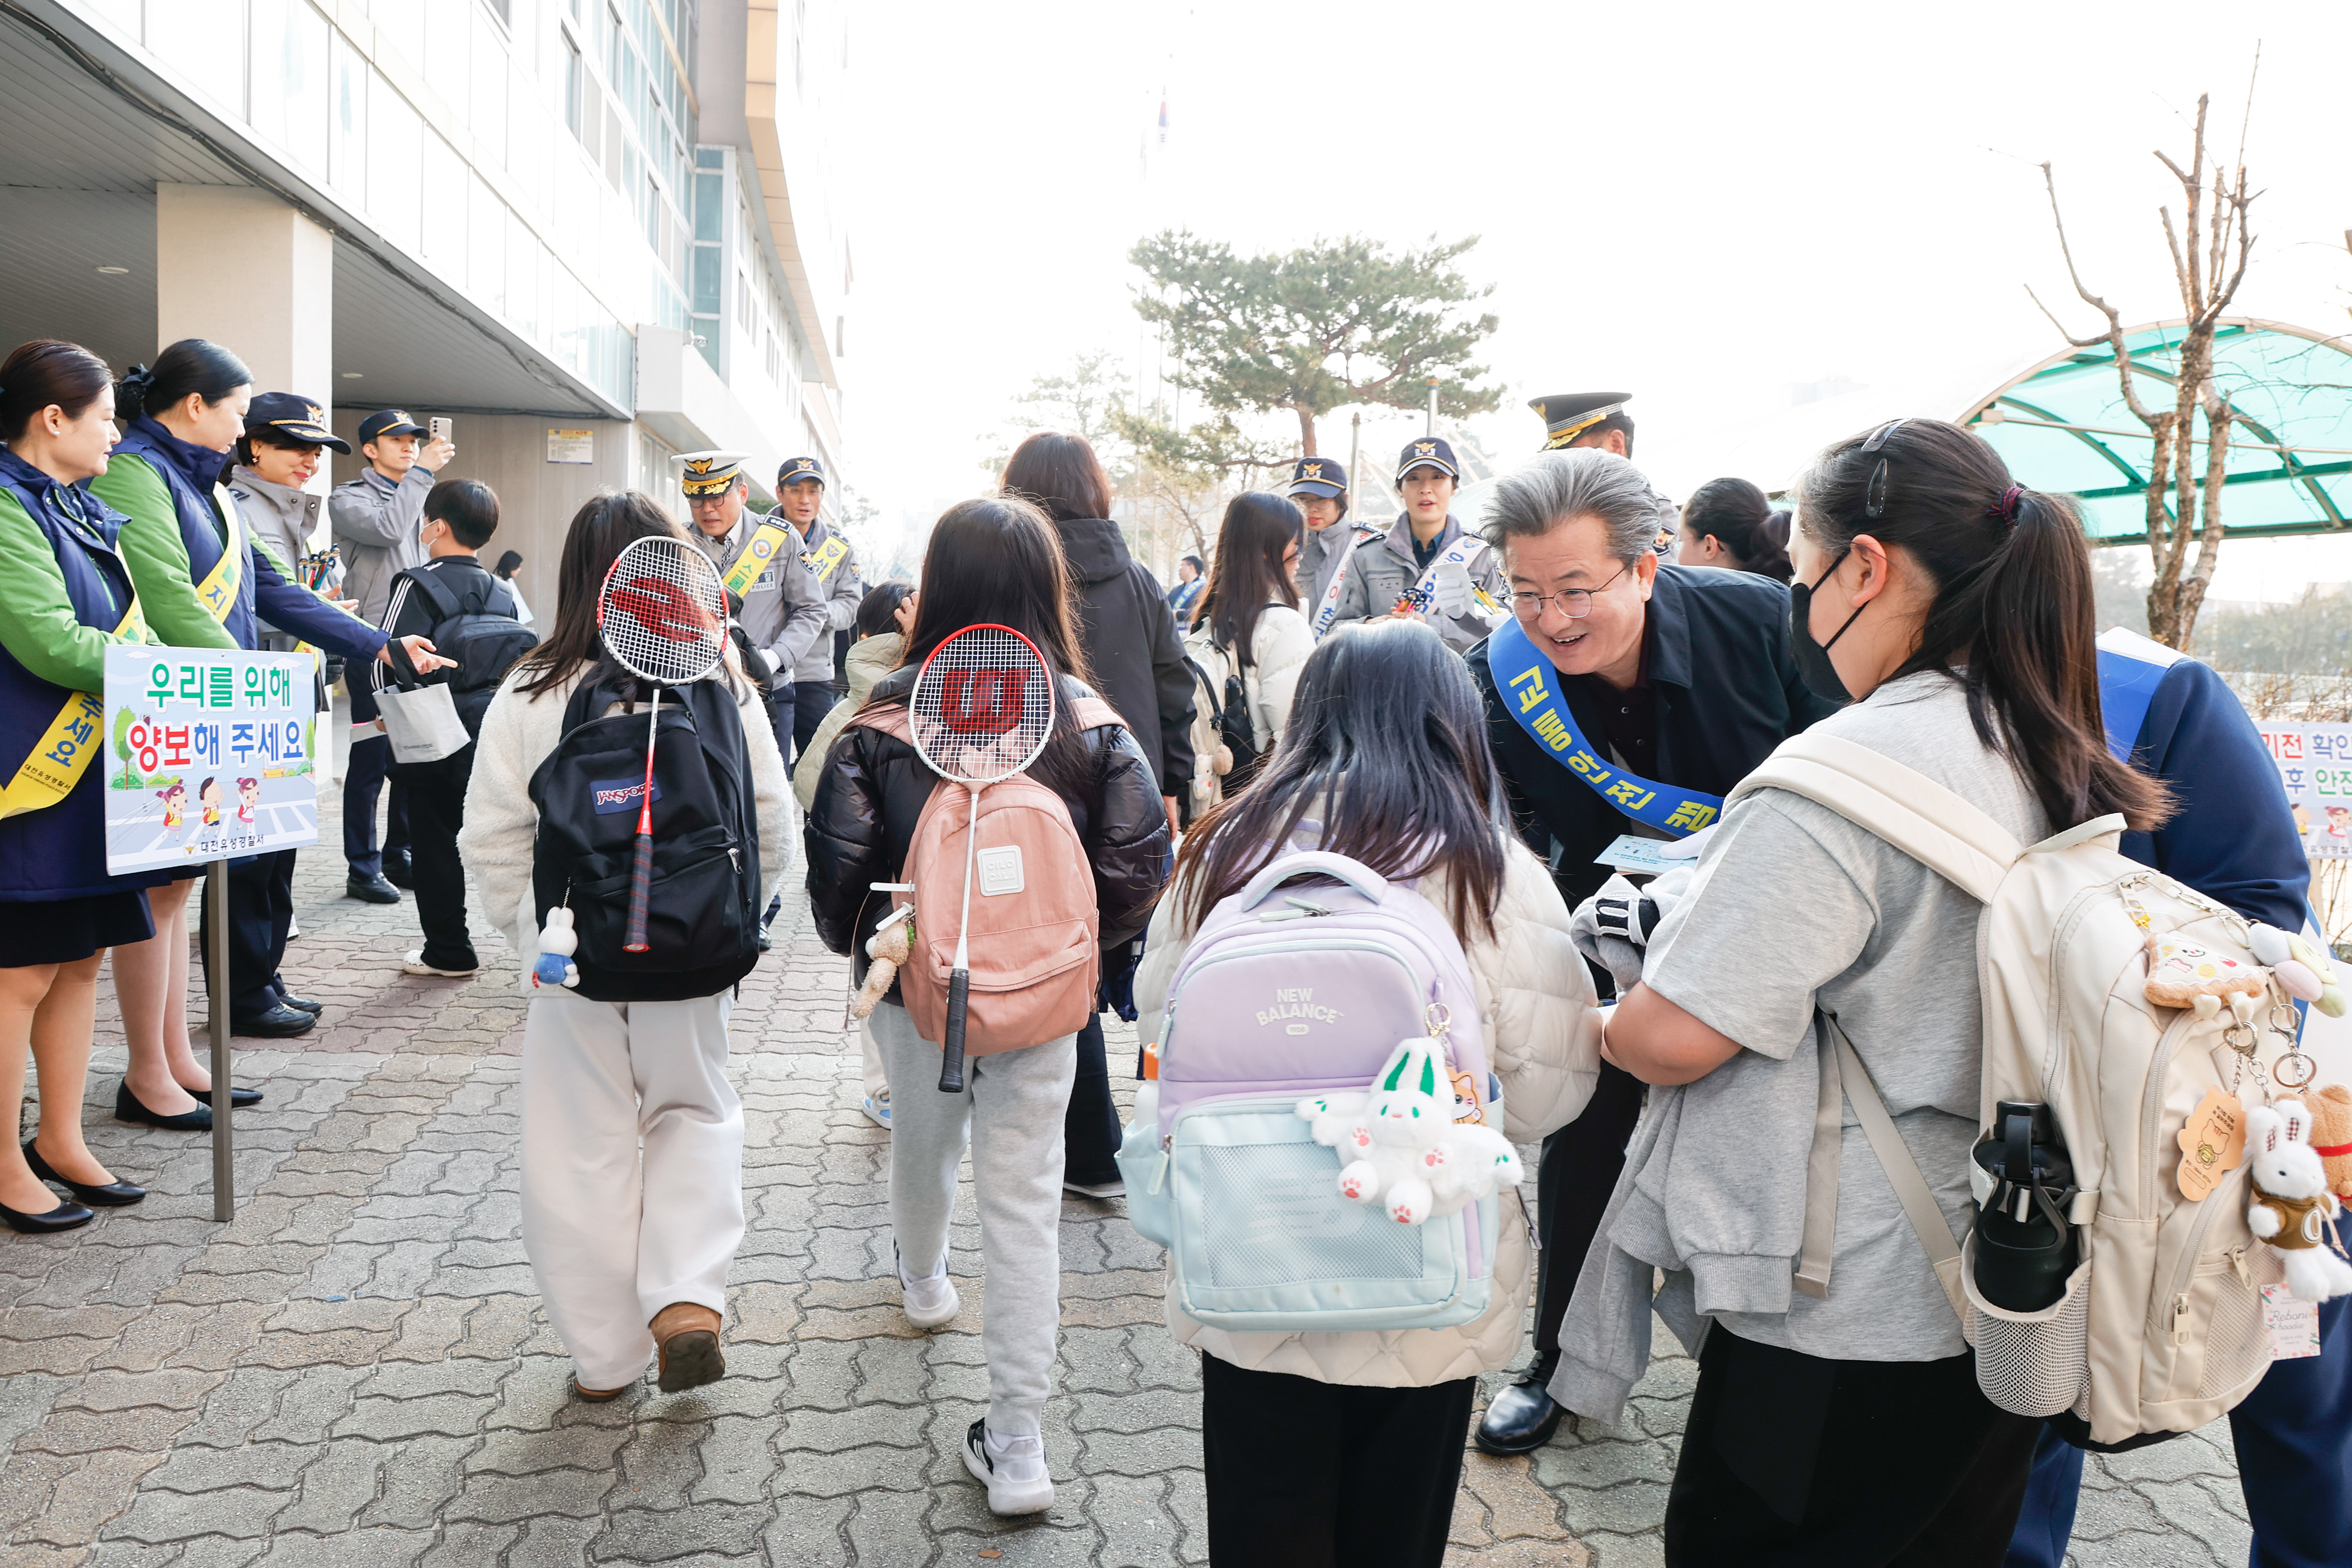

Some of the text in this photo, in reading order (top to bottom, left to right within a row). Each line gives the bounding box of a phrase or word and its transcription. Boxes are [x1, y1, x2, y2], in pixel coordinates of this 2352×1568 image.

[147, 664, 290, 707] 우리를 위해
[45, 694, 104, 767] 주세요
[1509, 665, 1657, 810] 교통안전
[130, 721, 303, 772] 양보해 주세요
[201, 832, 263, 853] 대전유성경찰서
[987, 859, 1014, 870] CILO
[989, 871, 1016, 882] CALA
[1276, 988, 1313, 1002] NEW
[1255, 1003, 1338, 1026] BALANCE
[2273, 1310, 2309, 1321] Reboni
